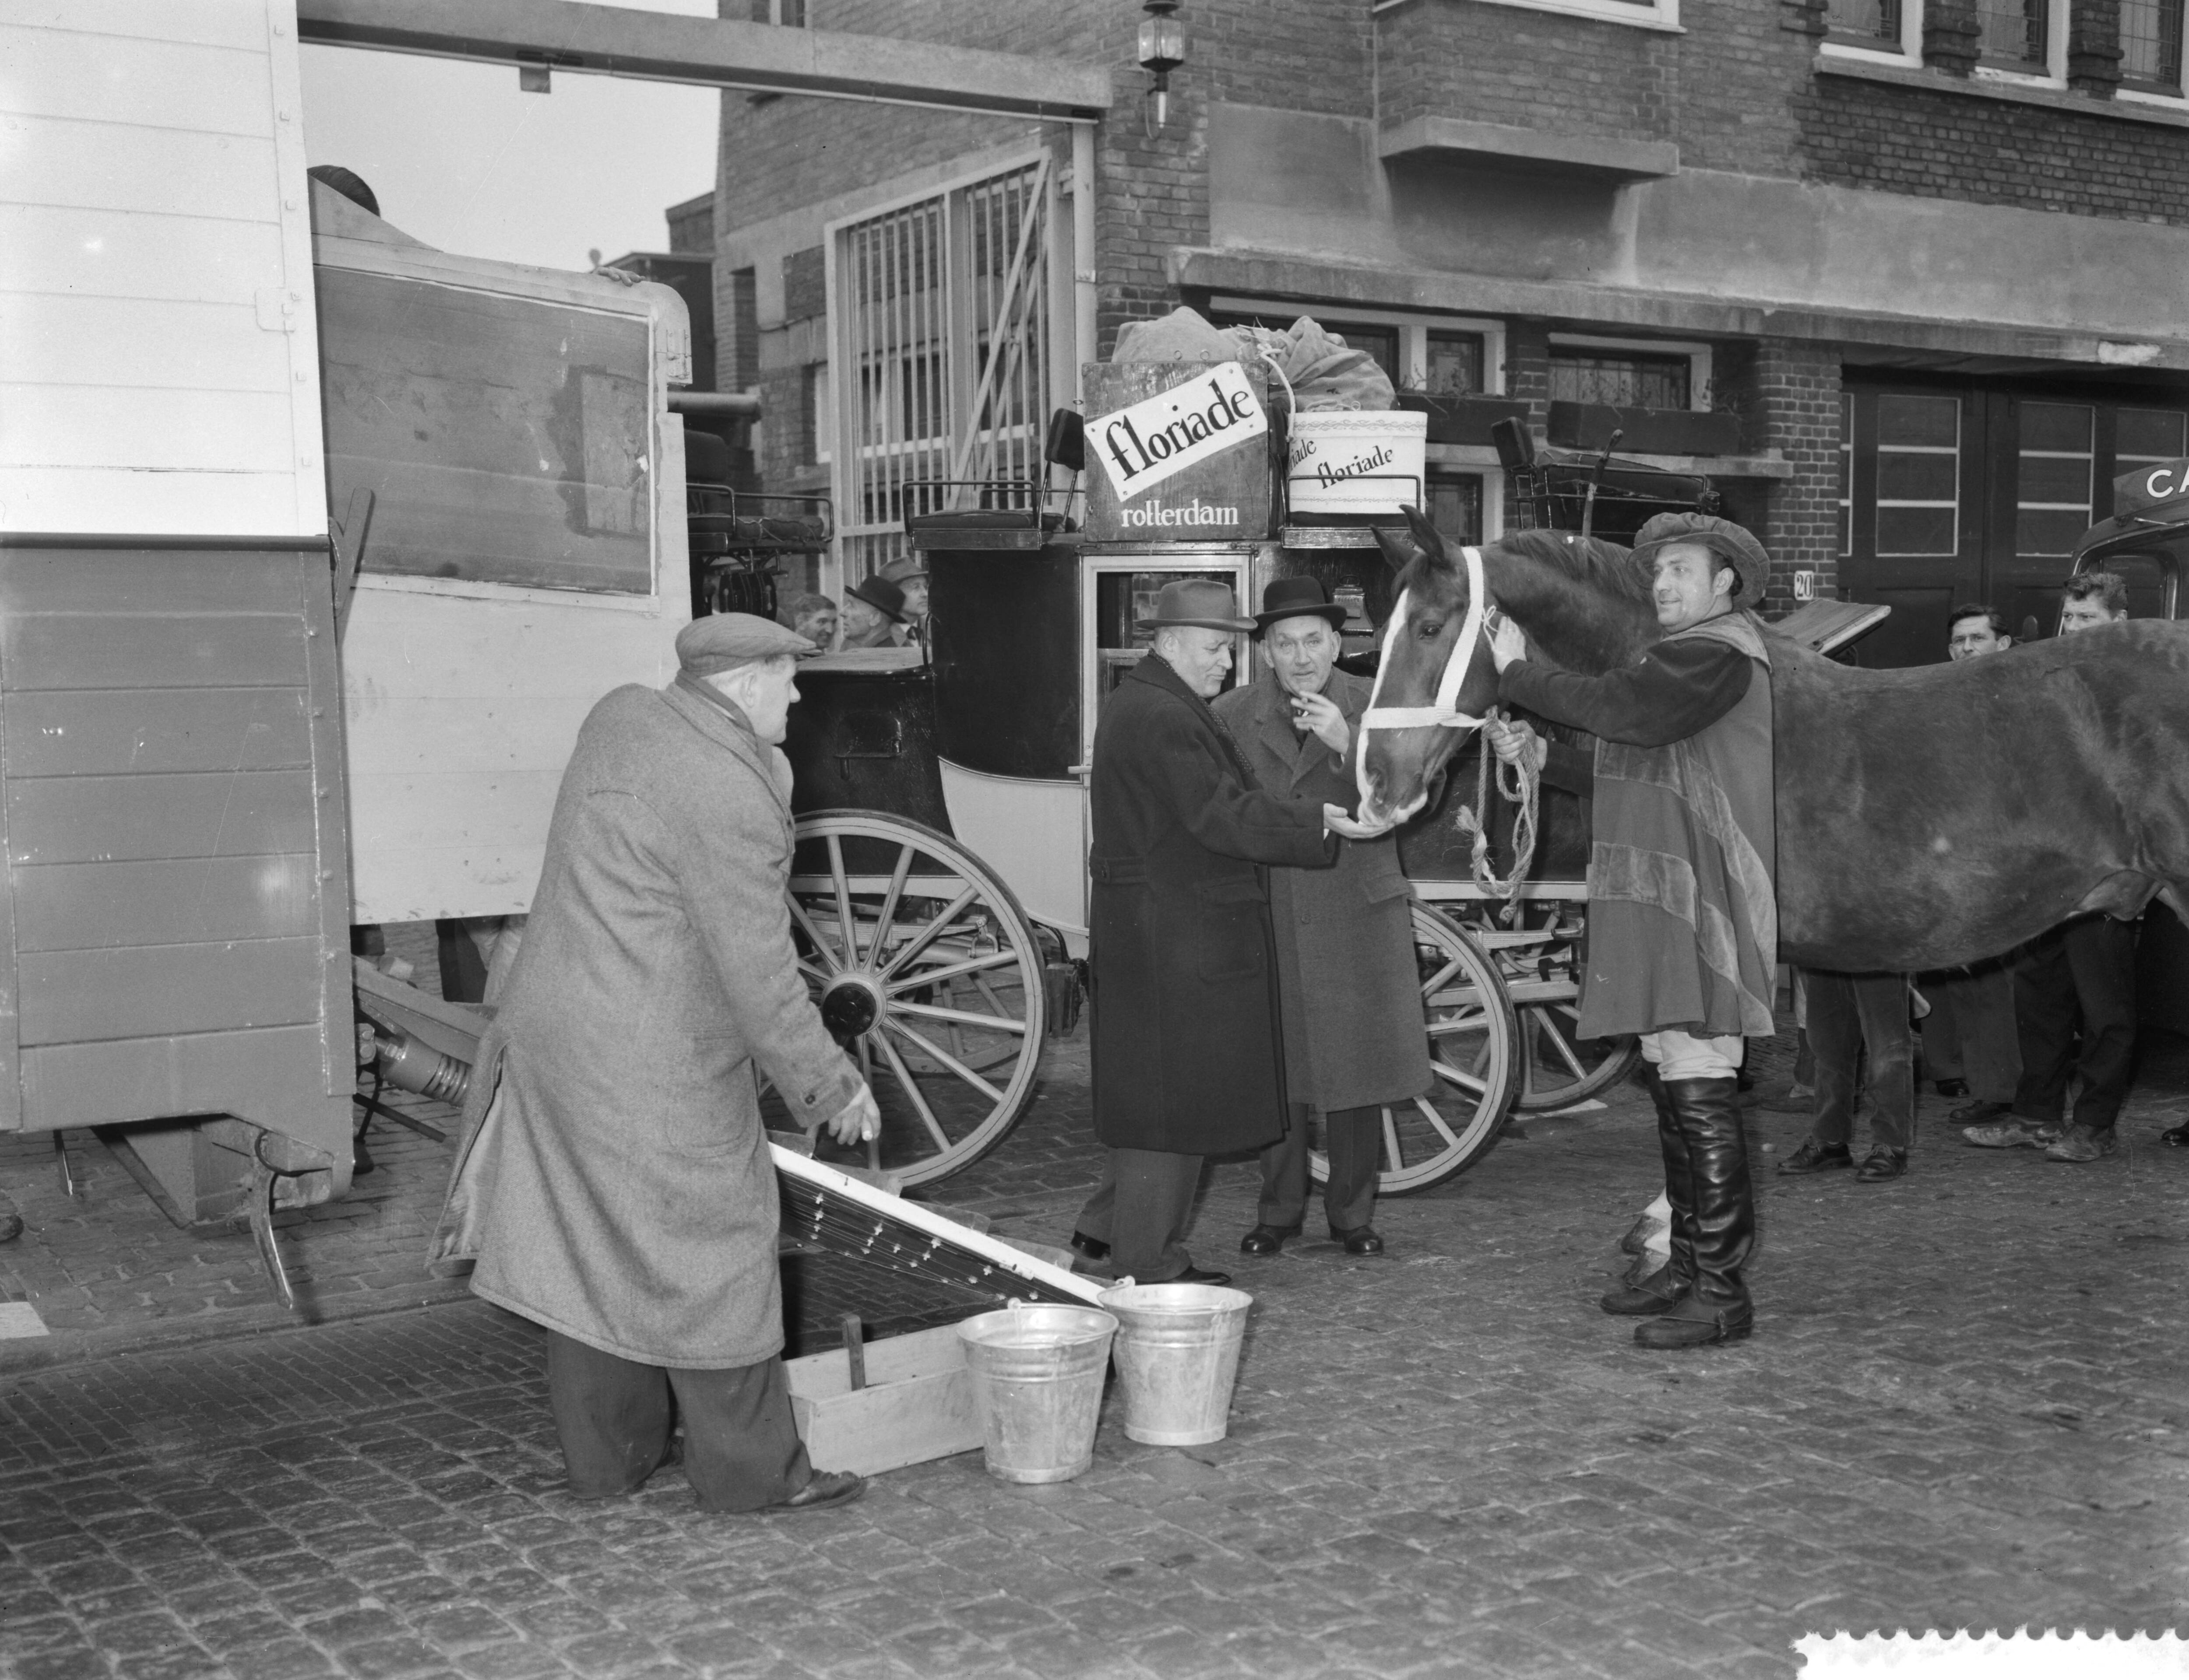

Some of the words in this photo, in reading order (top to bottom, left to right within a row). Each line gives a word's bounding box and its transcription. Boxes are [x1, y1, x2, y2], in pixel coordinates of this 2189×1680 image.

[1106, 378, 1254, 481] floriade
[1317, 445, 1393, 489] floriade
[1121, 498, 1239, 527] rotterdam
[1797, 574, 1812, 597] 20
